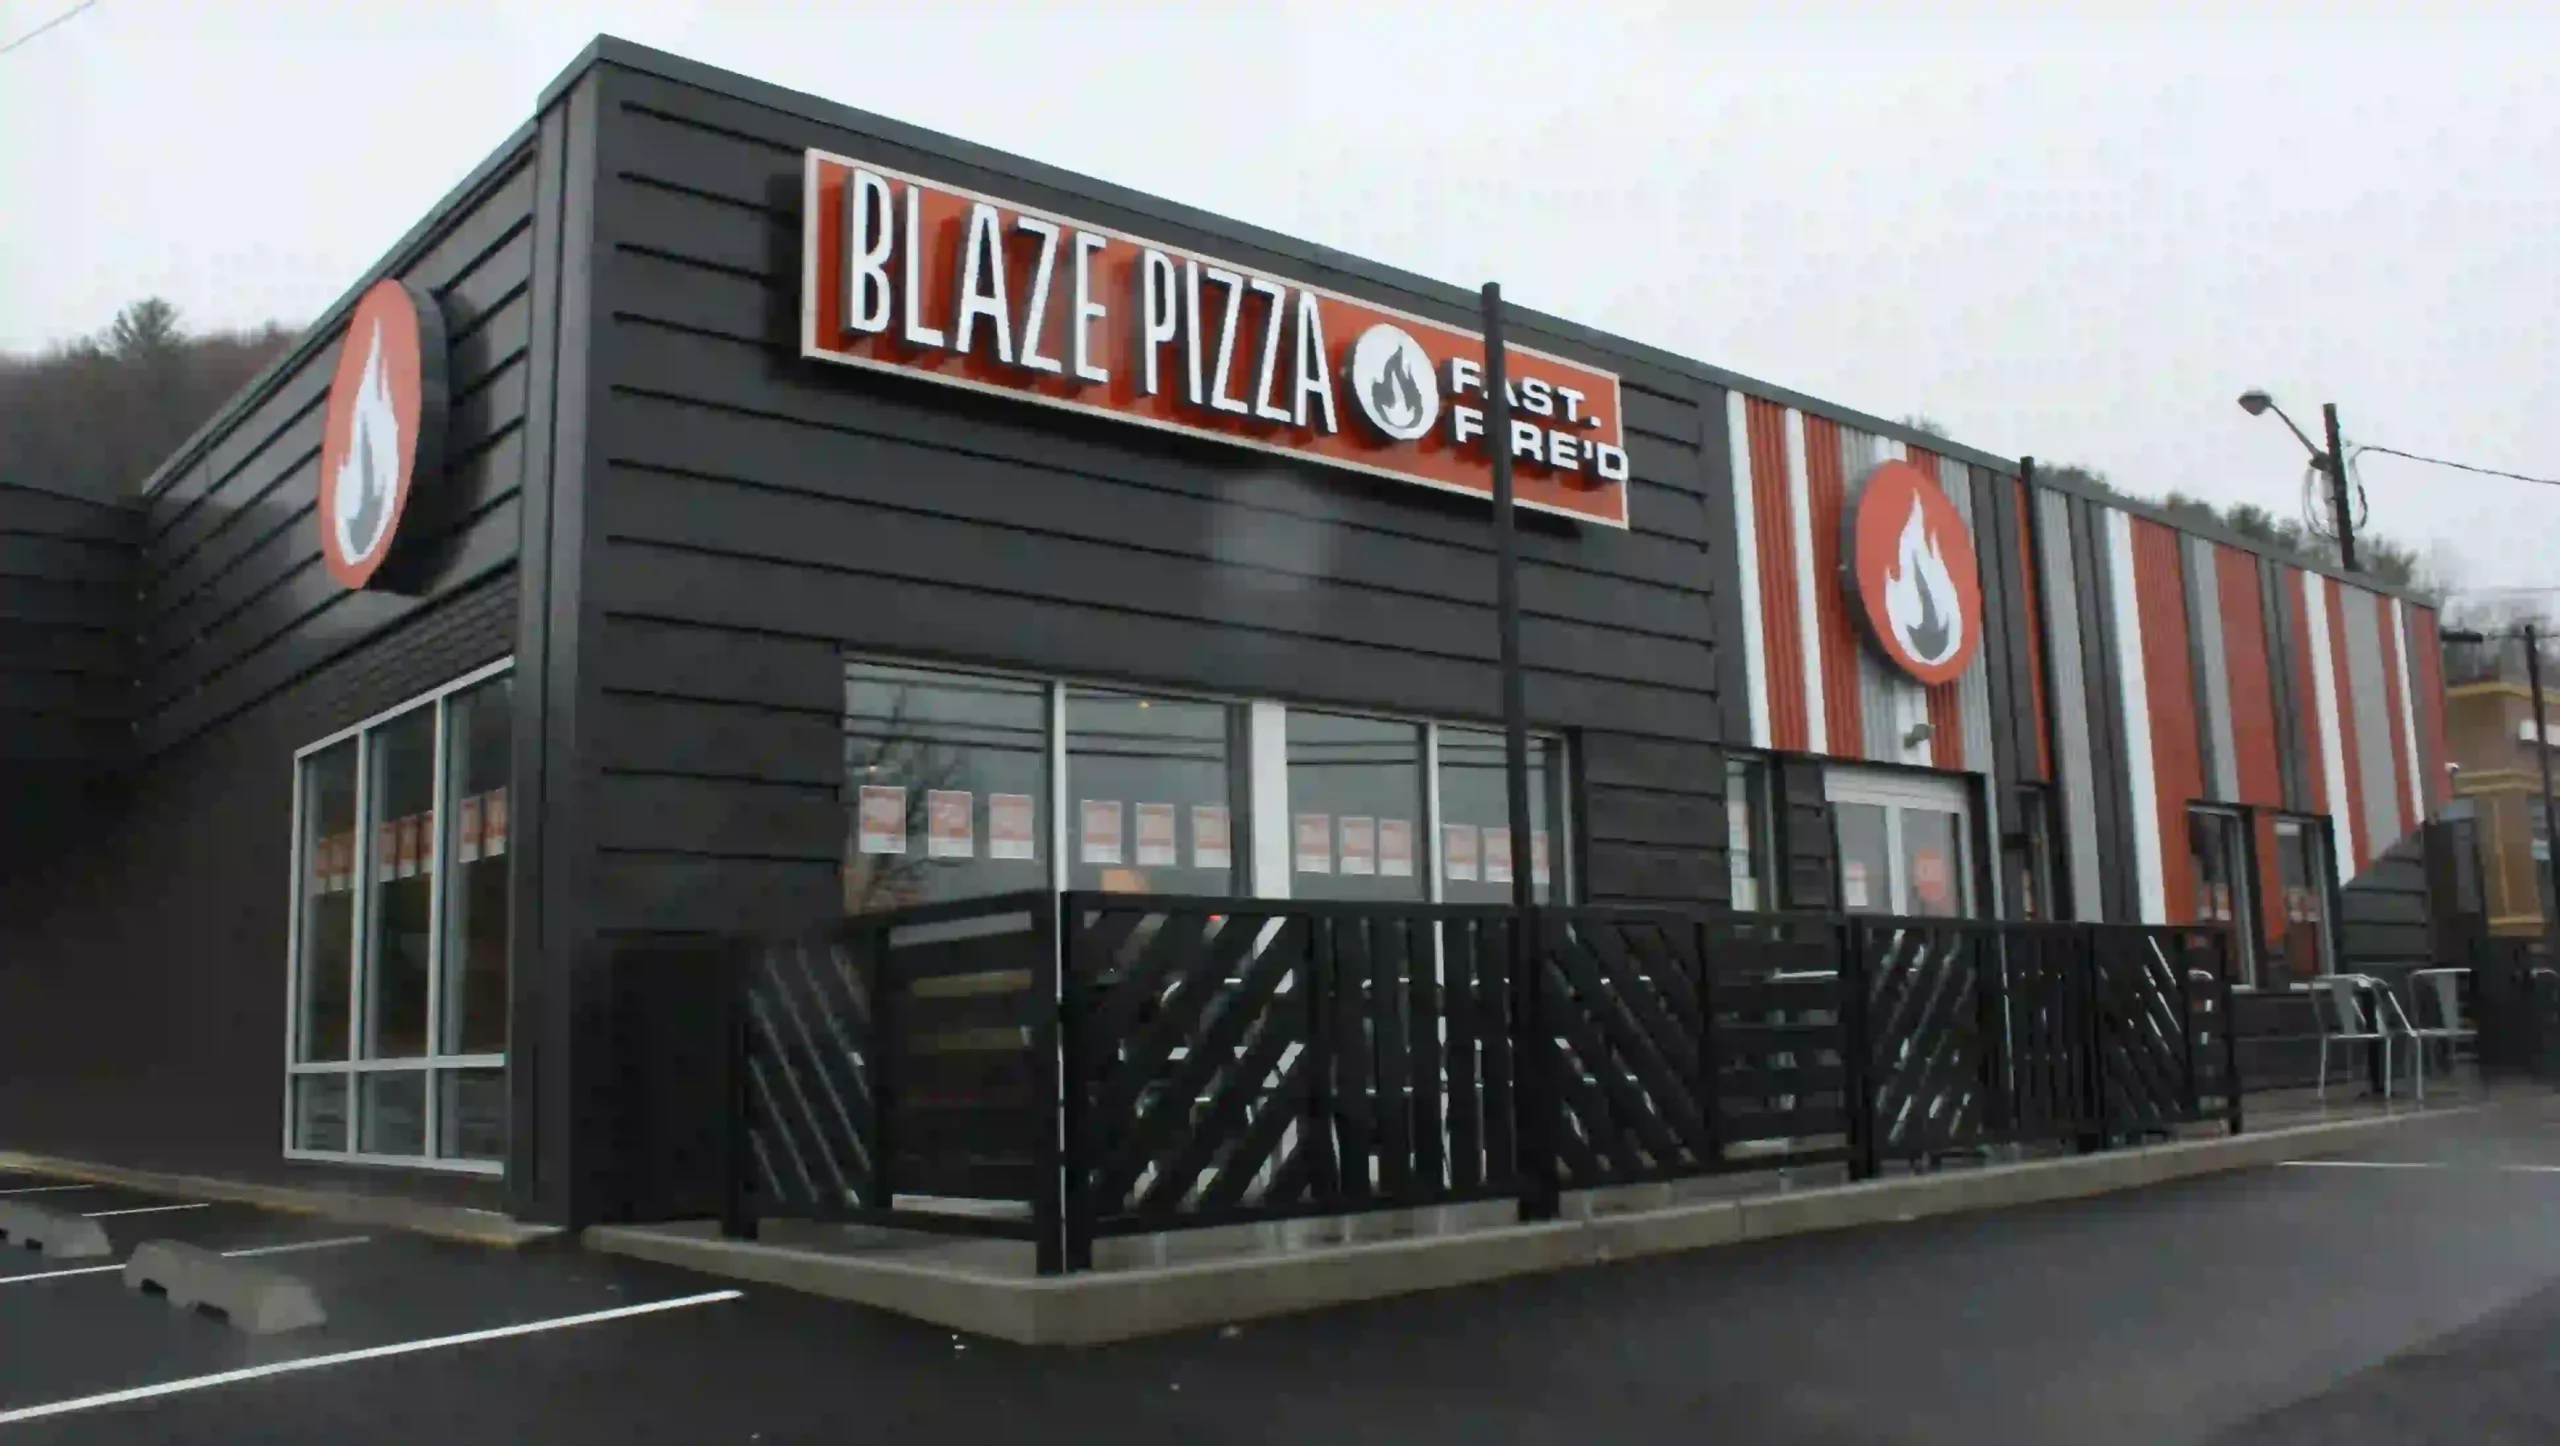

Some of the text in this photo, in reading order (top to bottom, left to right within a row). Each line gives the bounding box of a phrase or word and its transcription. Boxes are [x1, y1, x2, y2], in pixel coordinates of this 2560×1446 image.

[850, 168, 1339, 434] BLAZE PIZZA
[1453, 405, 1629, 481] FRE'D
